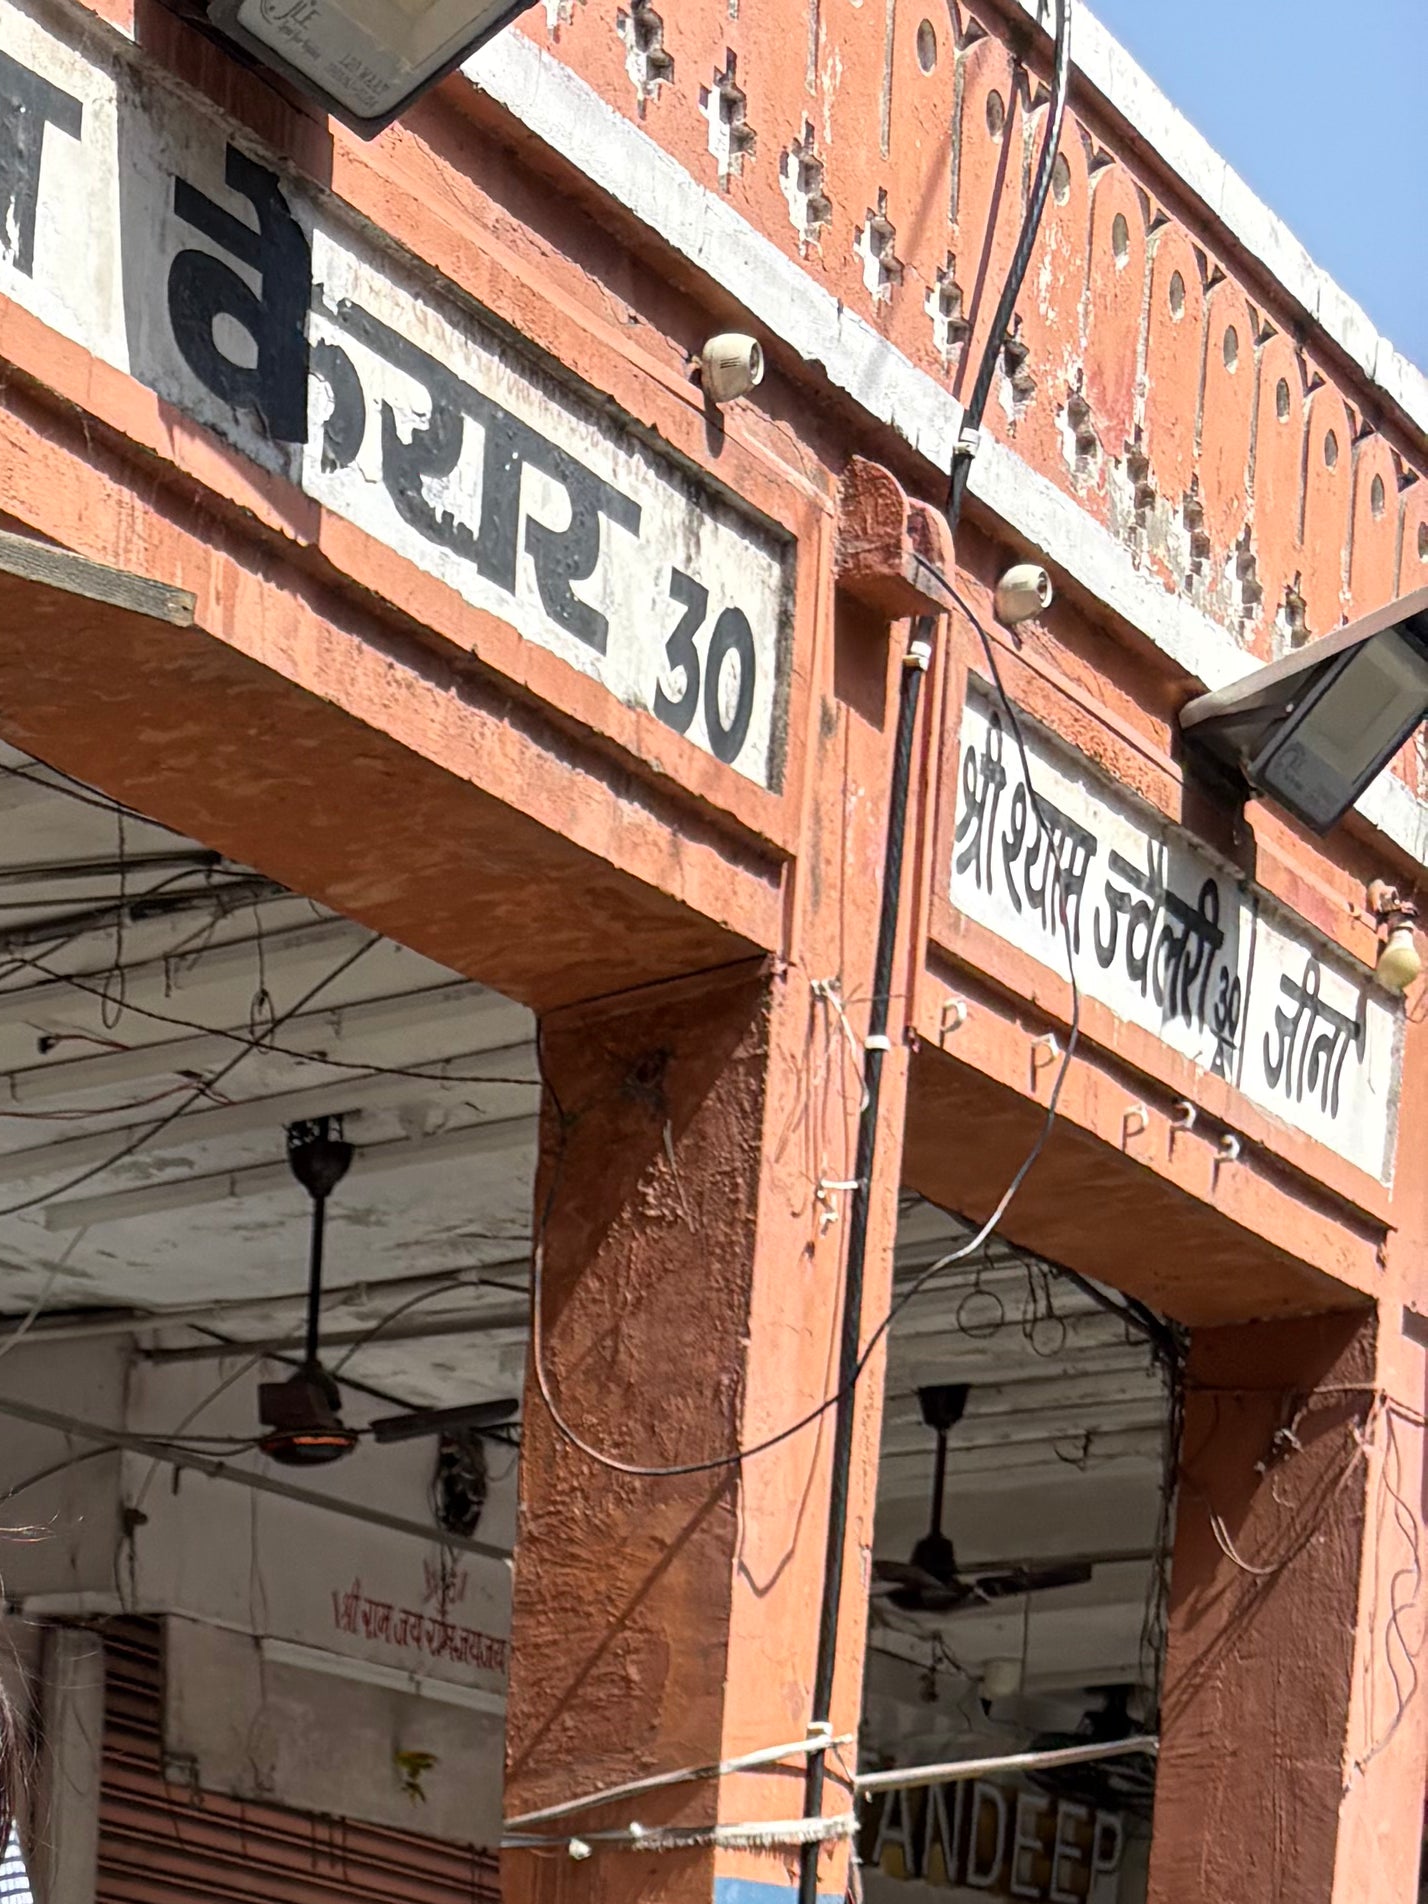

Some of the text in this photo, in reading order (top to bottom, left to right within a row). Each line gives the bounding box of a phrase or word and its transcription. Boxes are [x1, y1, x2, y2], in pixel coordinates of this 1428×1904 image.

[653, 566, 756, 764] 30
[956, 711, 1006, 896] श्री
[1214, 965, 1241, 1039] 30
